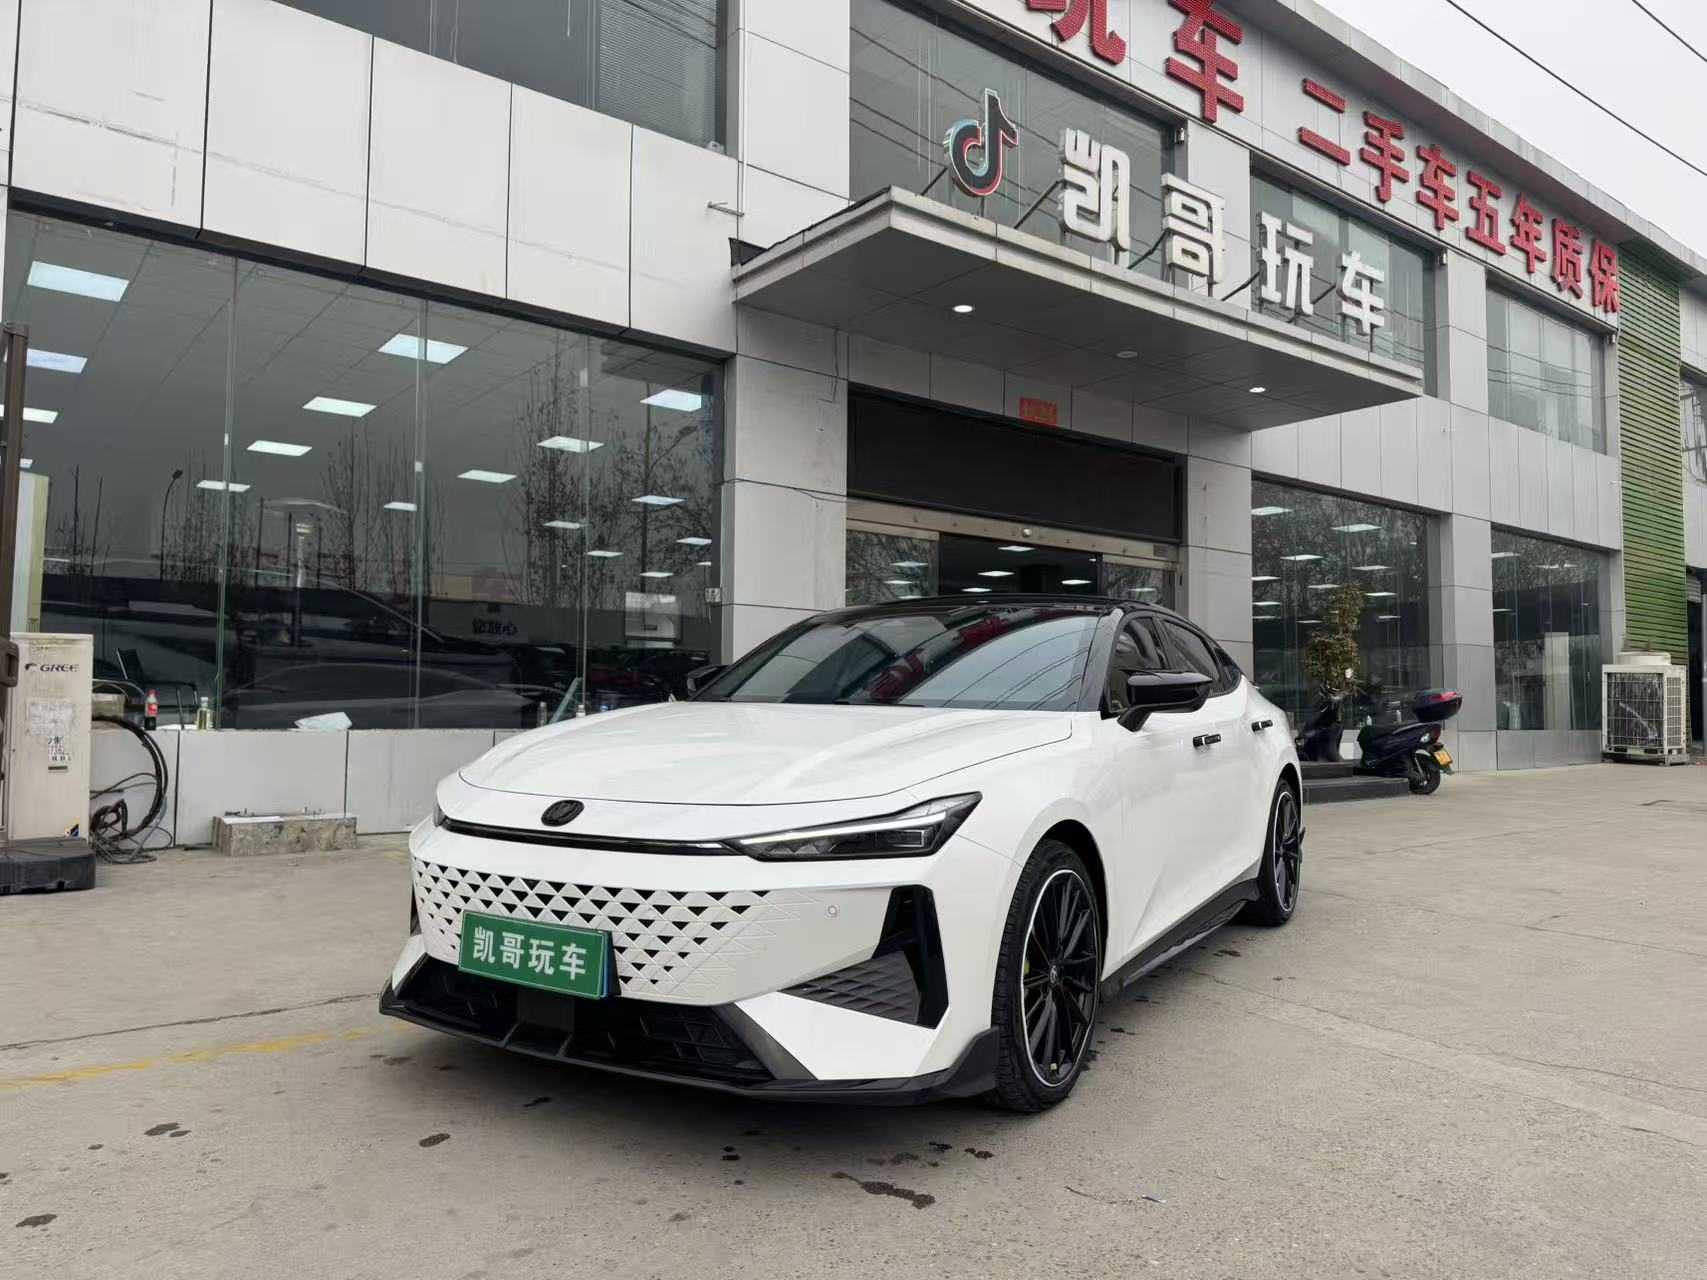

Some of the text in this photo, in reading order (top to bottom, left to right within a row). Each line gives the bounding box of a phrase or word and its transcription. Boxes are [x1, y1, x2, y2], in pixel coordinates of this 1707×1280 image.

[1061, 127, 1385, 336] 凯哥玩车
[1298, 78, 1621, 313] 二手车五年质保
[39, 663, 80, 673] GREE
[472, 926, 587, 981] 凯哥玩车
